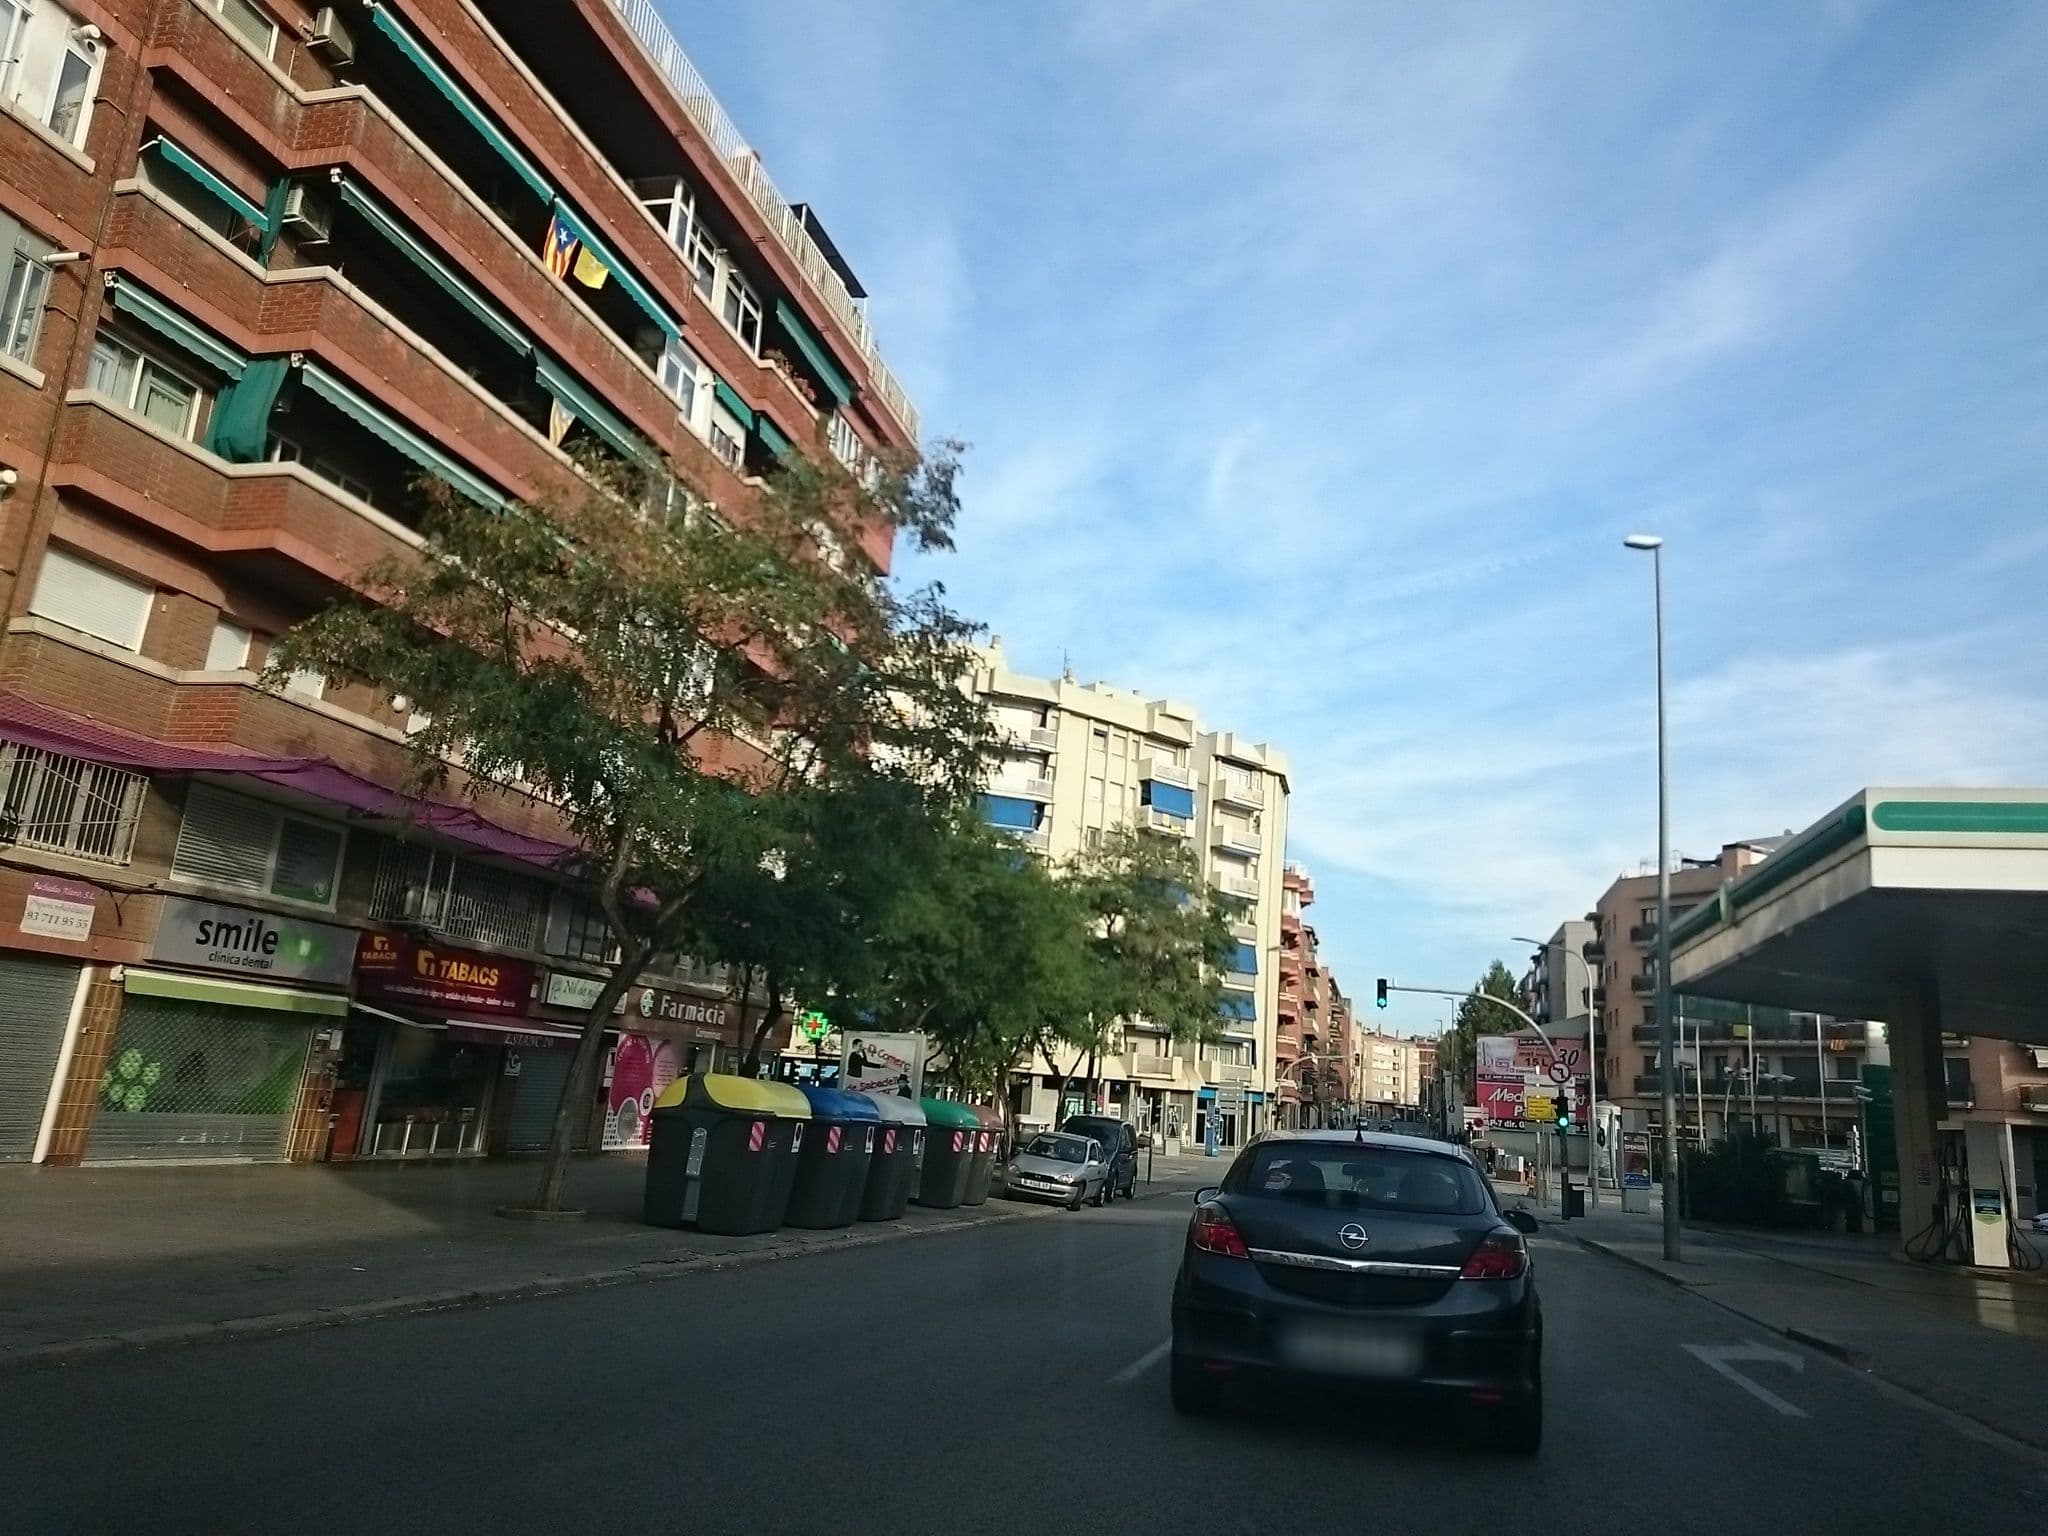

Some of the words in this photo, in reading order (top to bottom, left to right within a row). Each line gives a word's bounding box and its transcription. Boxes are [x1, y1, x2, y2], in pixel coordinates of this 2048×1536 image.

[42, 913, 60, 925] 711
[196, 919, 279, 955] smile
[242, 955, 274, 969] dental
[362, 951, 398, 961] TABACS
[439, 959, 500, 987] TABACS
[659, 995, 726, 1025] Farmàcia
